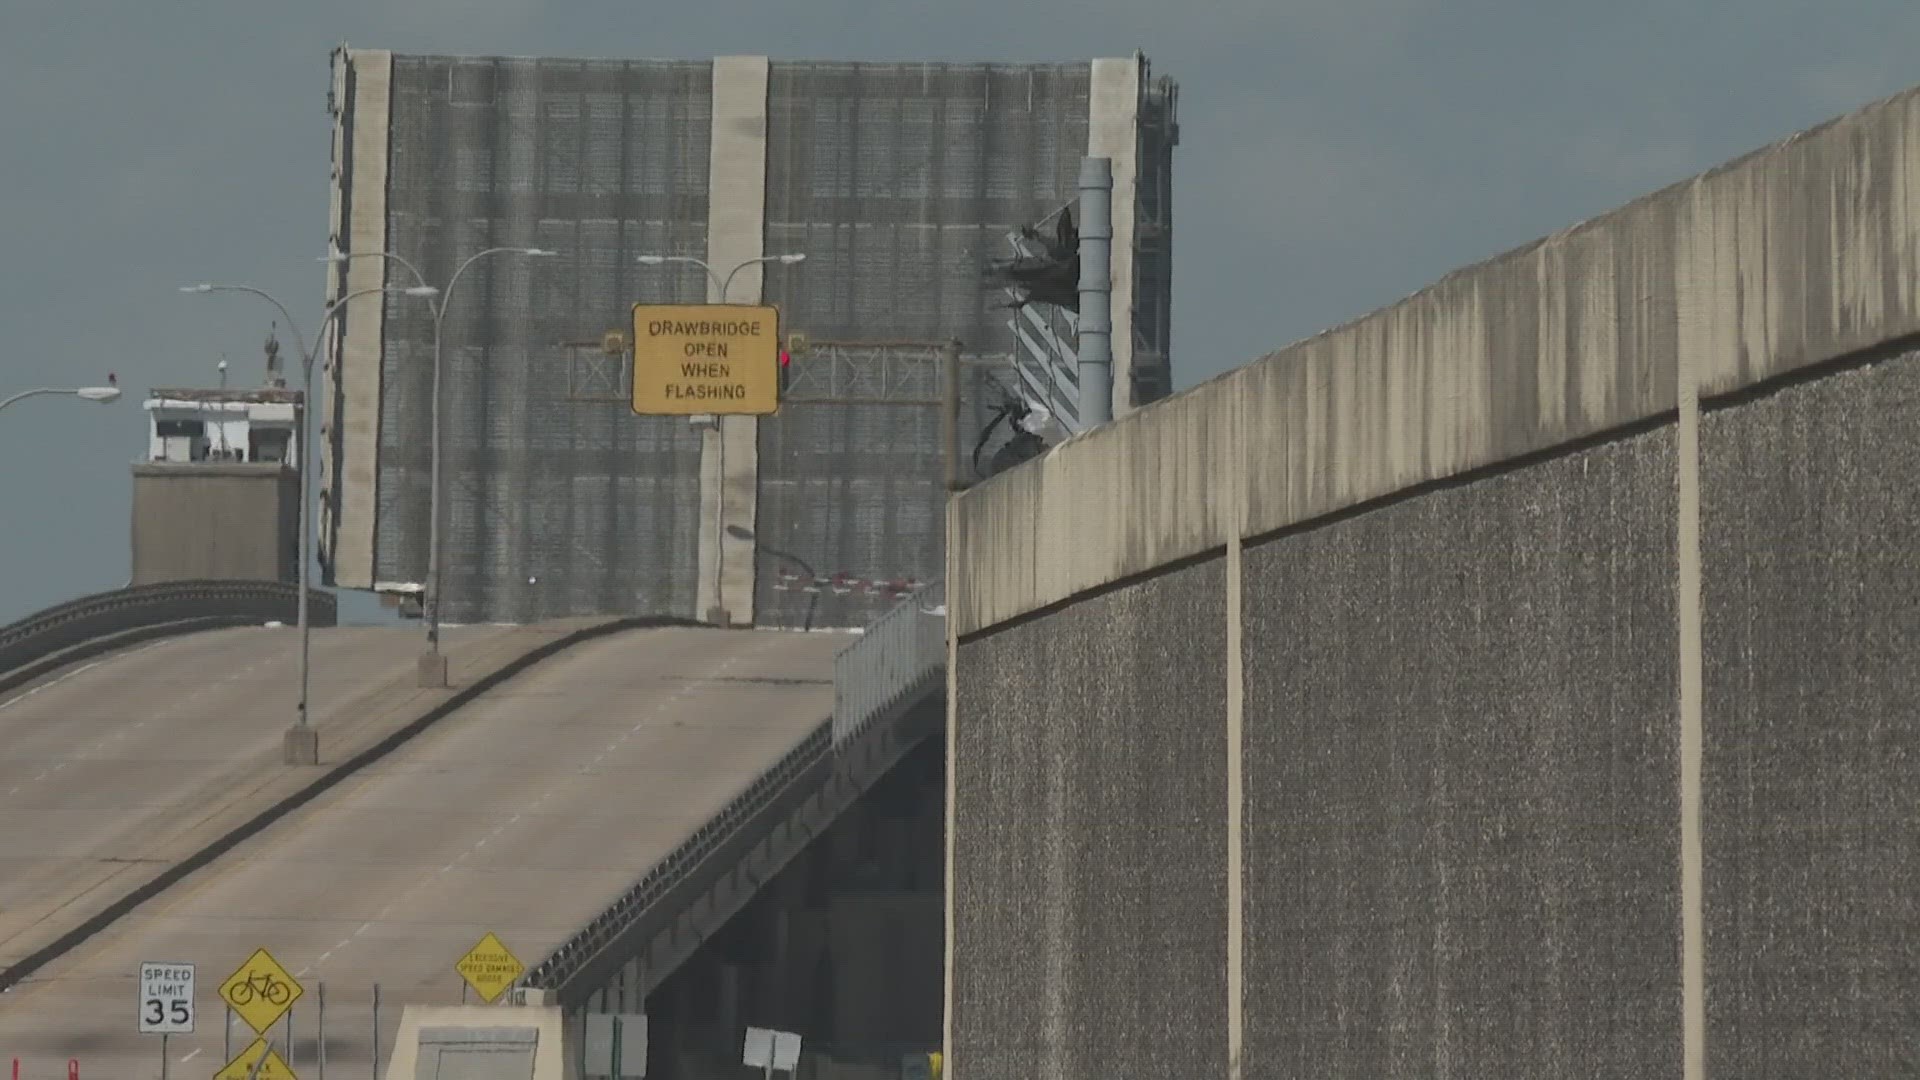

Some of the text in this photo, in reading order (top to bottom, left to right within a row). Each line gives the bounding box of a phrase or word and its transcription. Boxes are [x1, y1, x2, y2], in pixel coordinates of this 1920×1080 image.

[649, 320, 760, 336] DRAWBRIDGE
[684, 342, 728, 358] OPEN
[681, 362, 730, 377] WHEN
[665, 384, 746, 399] FLASHING
[145, 969, 191, 981] SPEED
[149, 984, 185, 996] LIMIT
[145, 999, 189, 1025] 35
